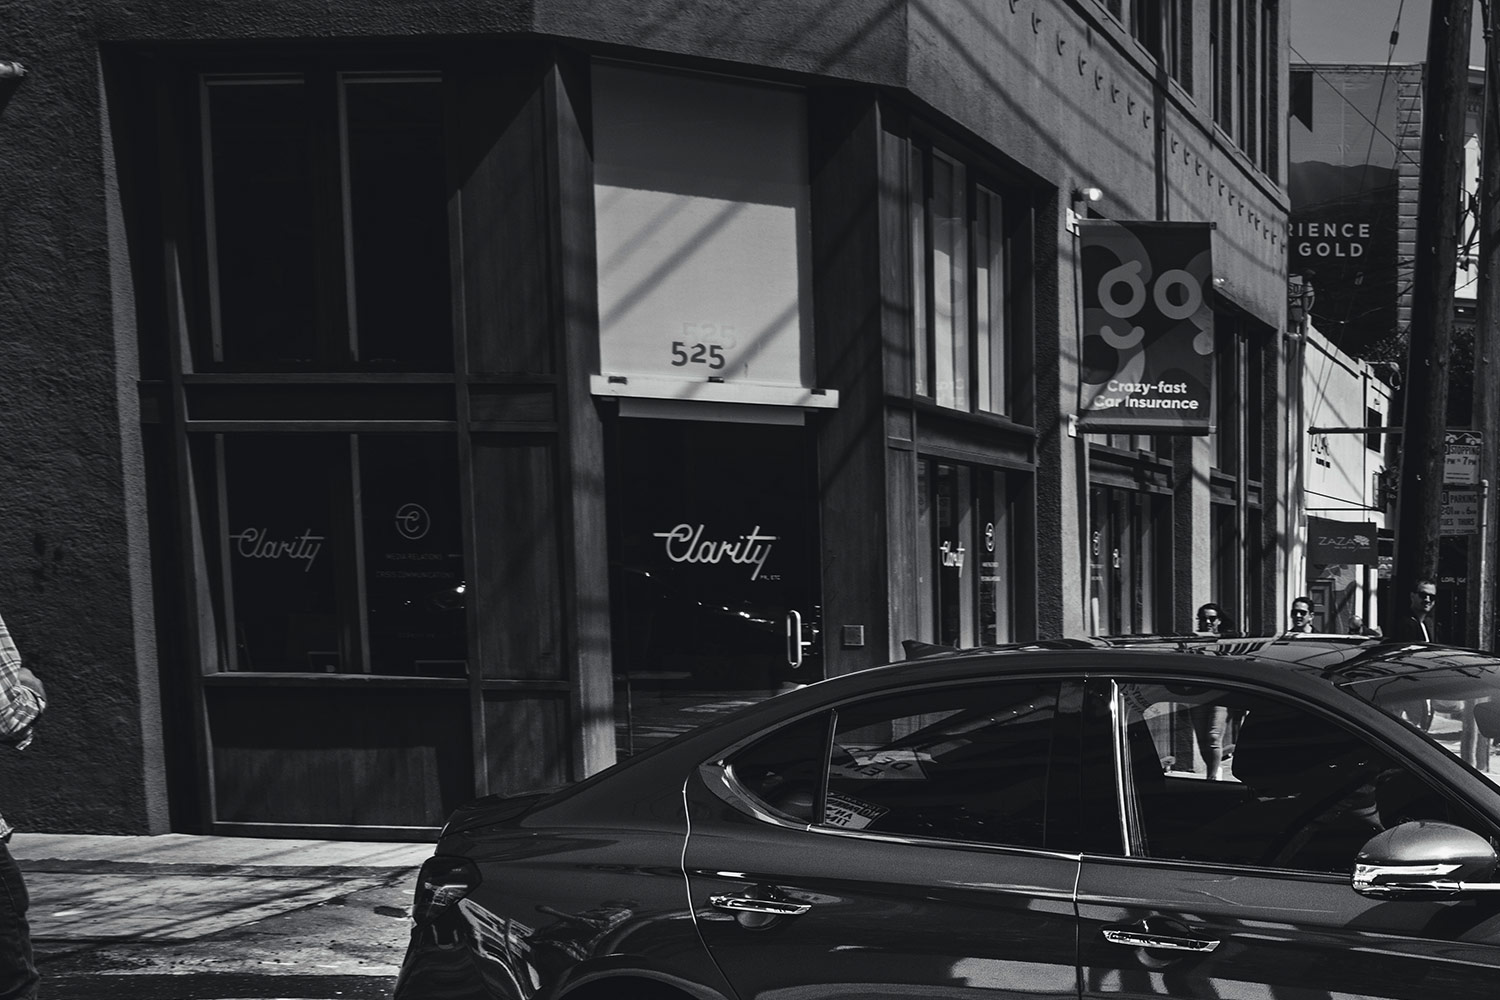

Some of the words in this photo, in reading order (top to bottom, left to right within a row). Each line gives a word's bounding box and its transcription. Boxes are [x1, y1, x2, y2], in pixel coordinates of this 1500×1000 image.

[1298, 241, 1364, 257] GOLD
[671, 341, 725, 369] 525
[1107, 379, 1188, 396] Crazy-fast
[1093, 394, 1123, 409] Car
[1450, 444, 1480, 455] STOPPING
[1450, 494, 1477, 503] PARKING
[1318, 536, 1356, 546] ZAZA
[229, 527, 326, 573] Clarity
[652, 523, 778, 581] Clarity
